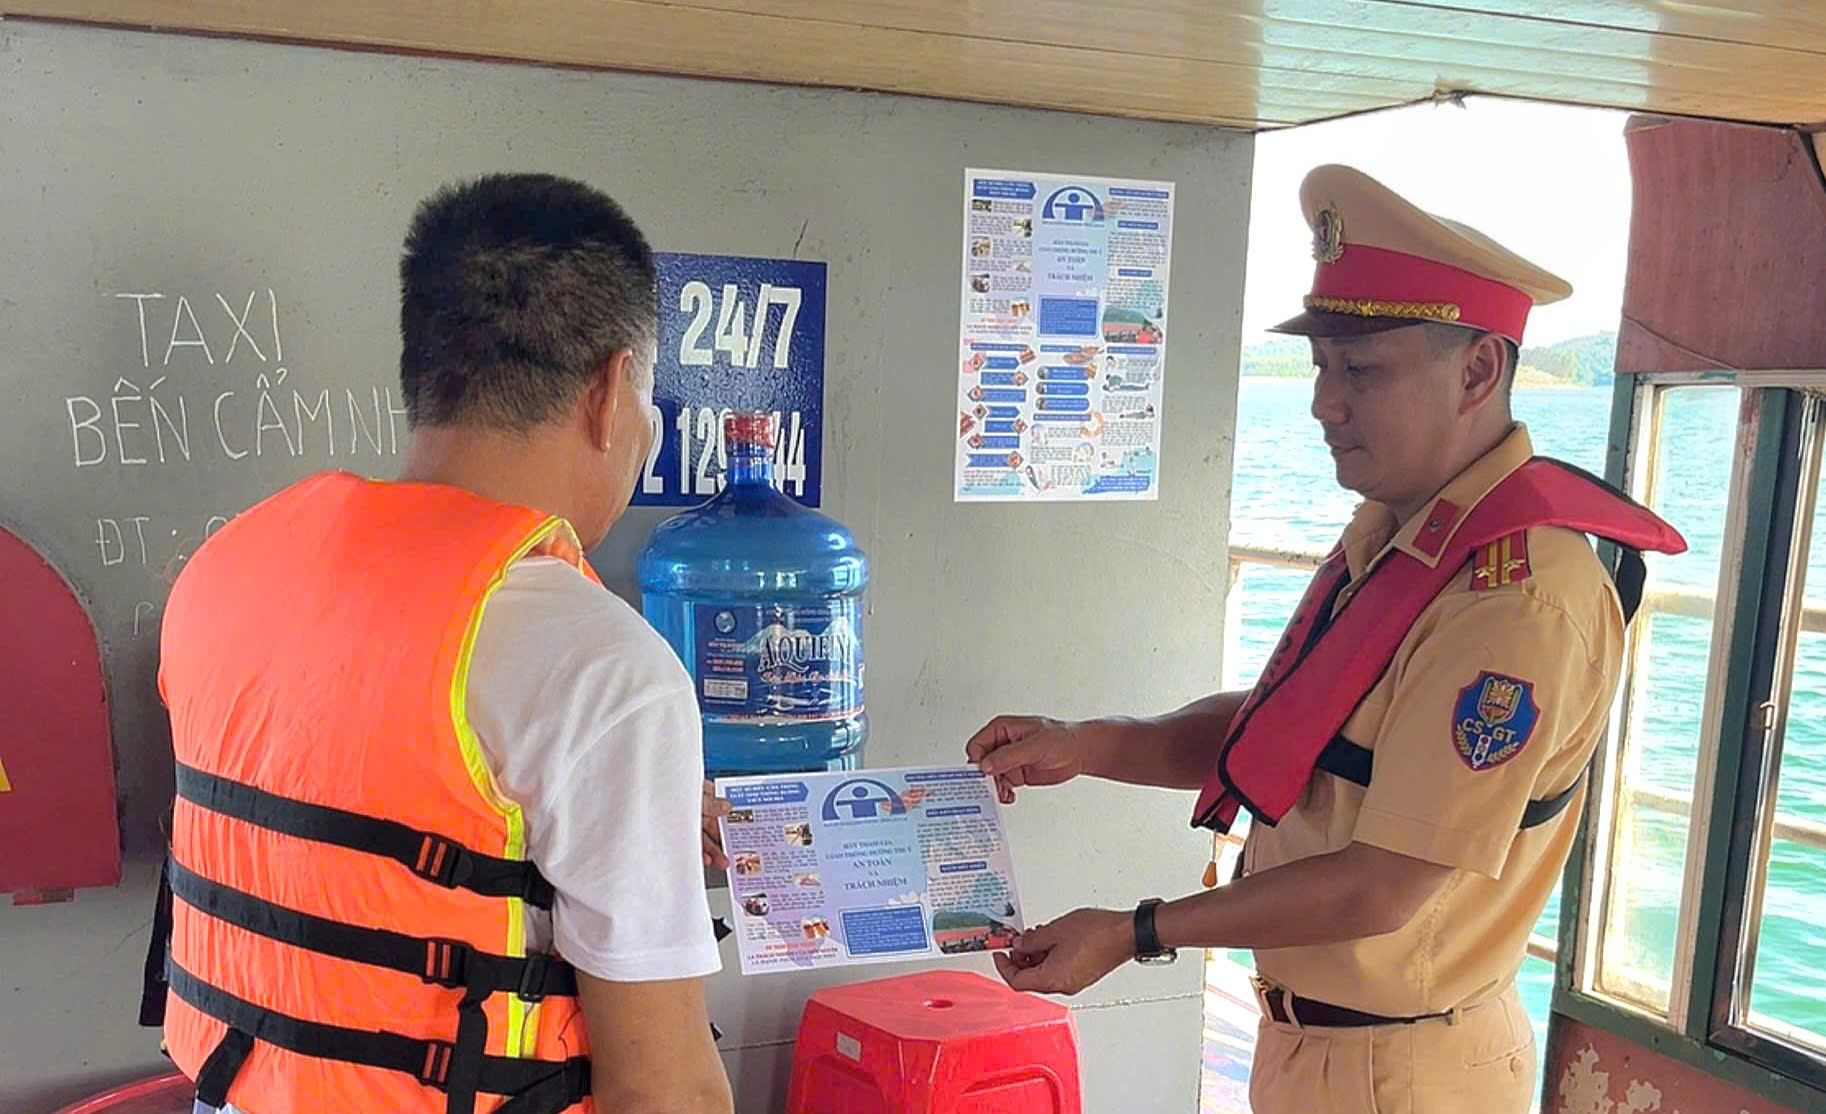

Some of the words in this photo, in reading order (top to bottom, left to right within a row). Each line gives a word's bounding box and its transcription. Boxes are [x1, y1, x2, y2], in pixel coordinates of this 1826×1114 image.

[113, 288, 282, 367] TAXI
[680, 281, 802, 368] 24/7
[66, 376, 190, 467] BẾN
[214, 367, 335, 459] CẨM
